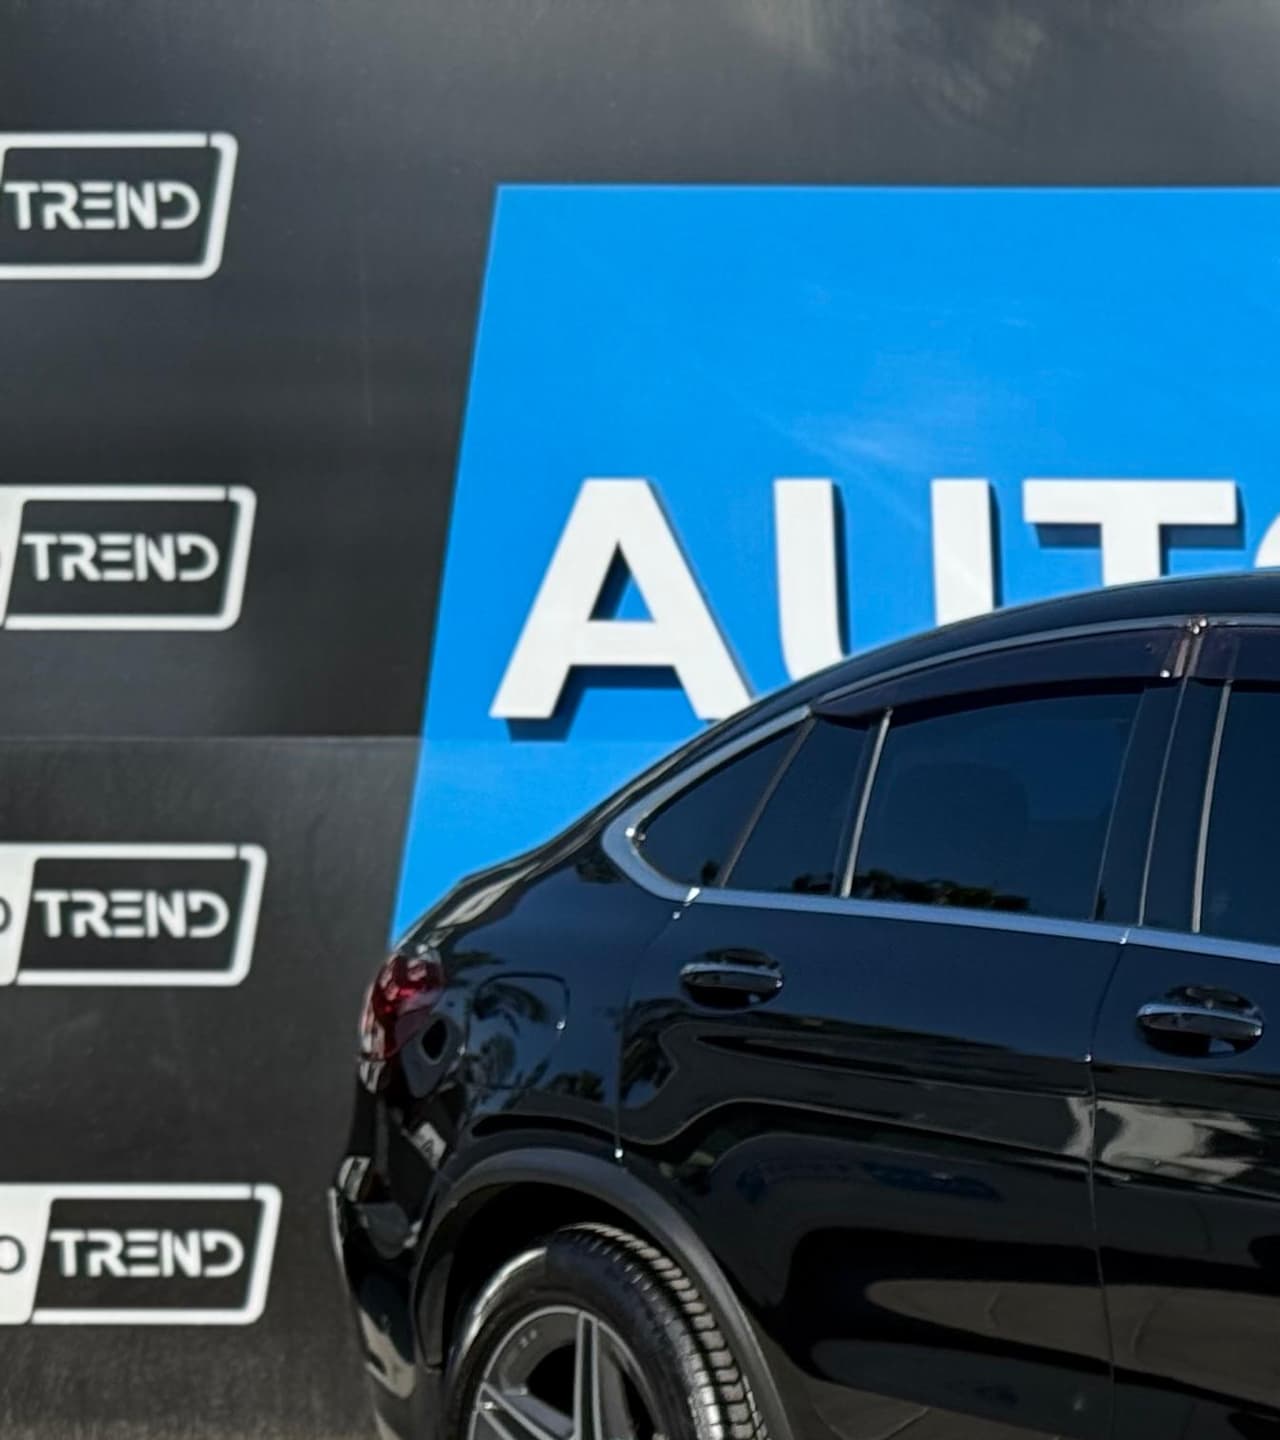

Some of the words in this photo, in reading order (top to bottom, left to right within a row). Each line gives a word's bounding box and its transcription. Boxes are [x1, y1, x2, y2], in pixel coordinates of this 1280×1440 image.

[4, 181, 201, 230] TREND
[22, 533, 219, 582] TREND
[34, 890, 229, 938] TREND
[49, 1229, 244, 1277] TREND
